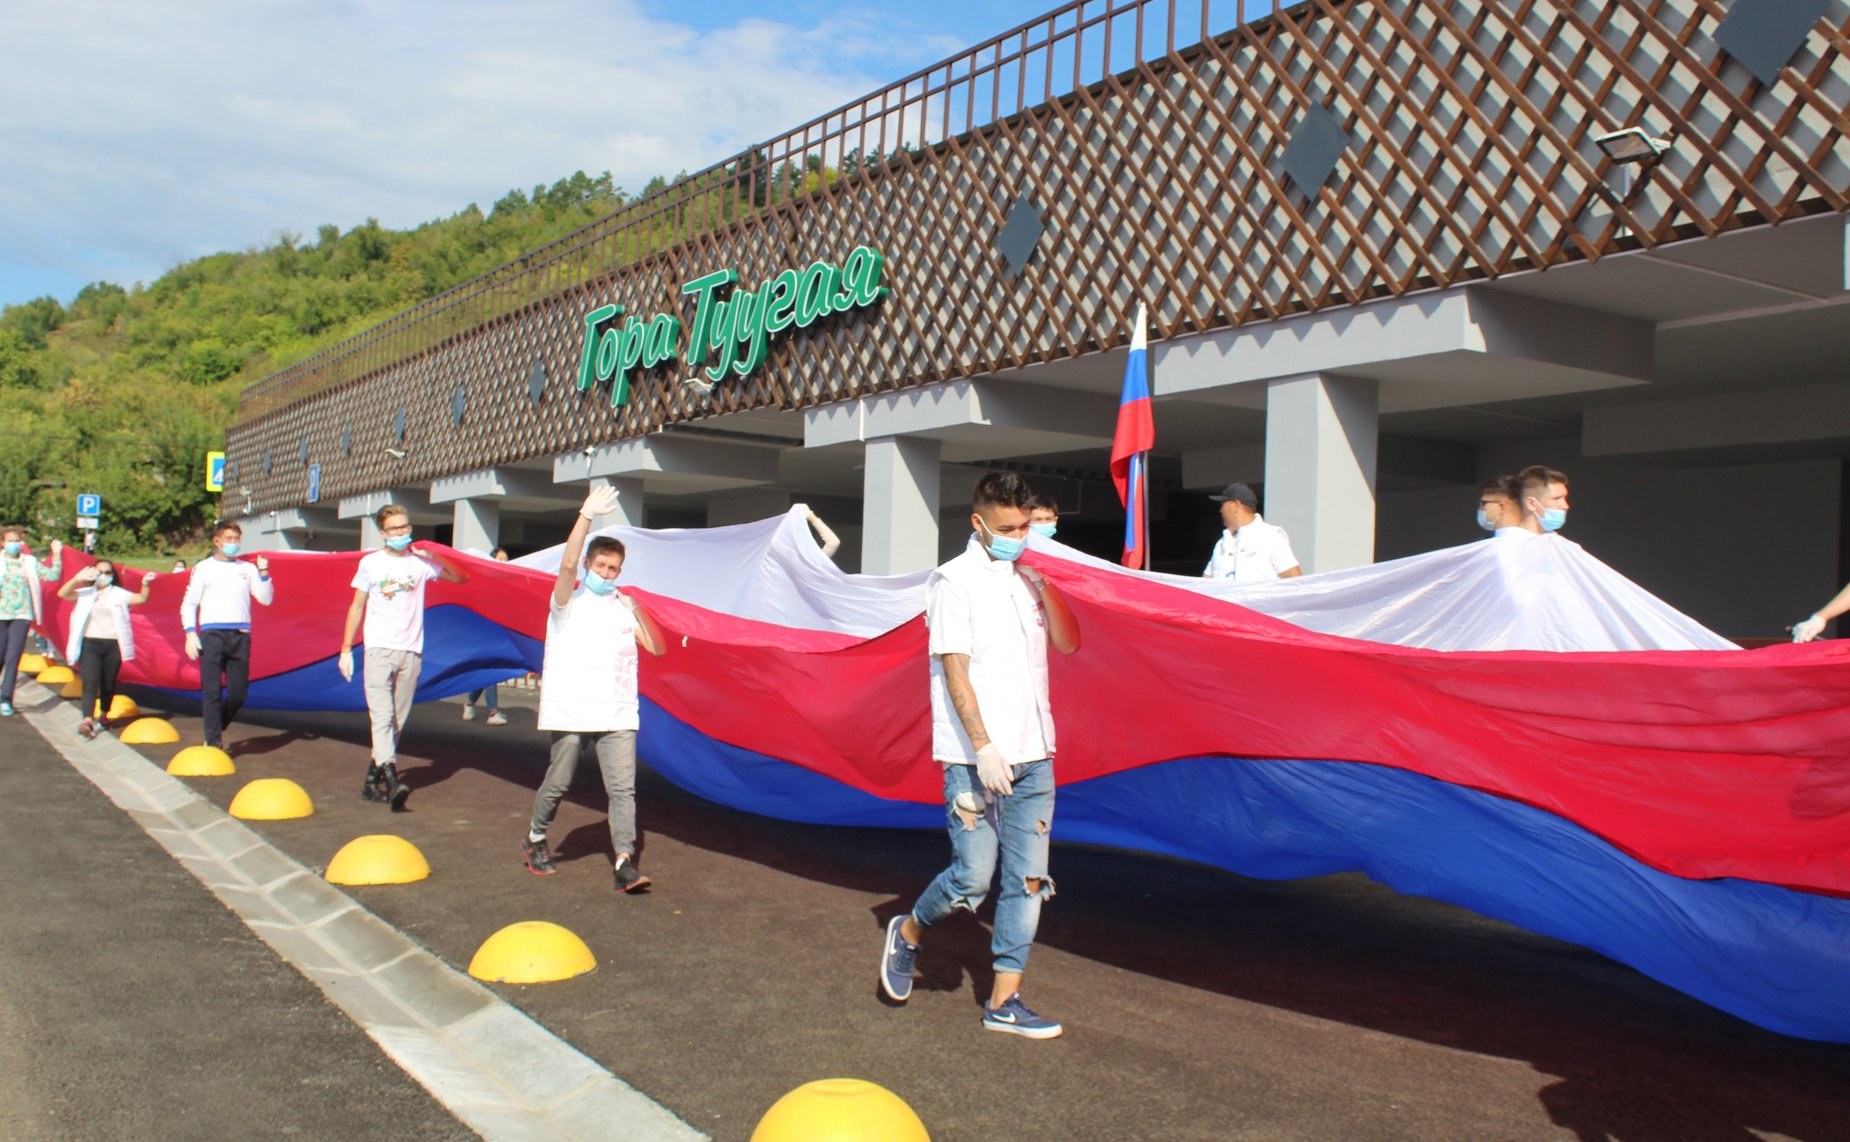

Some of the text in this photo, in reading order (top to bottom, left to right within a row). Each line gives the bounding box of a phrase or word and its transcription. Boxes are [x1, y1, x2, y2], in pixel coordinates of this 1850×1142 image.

[577, 245, 888, 407] Гора Туугая
[82, 497, 95, 513] P
